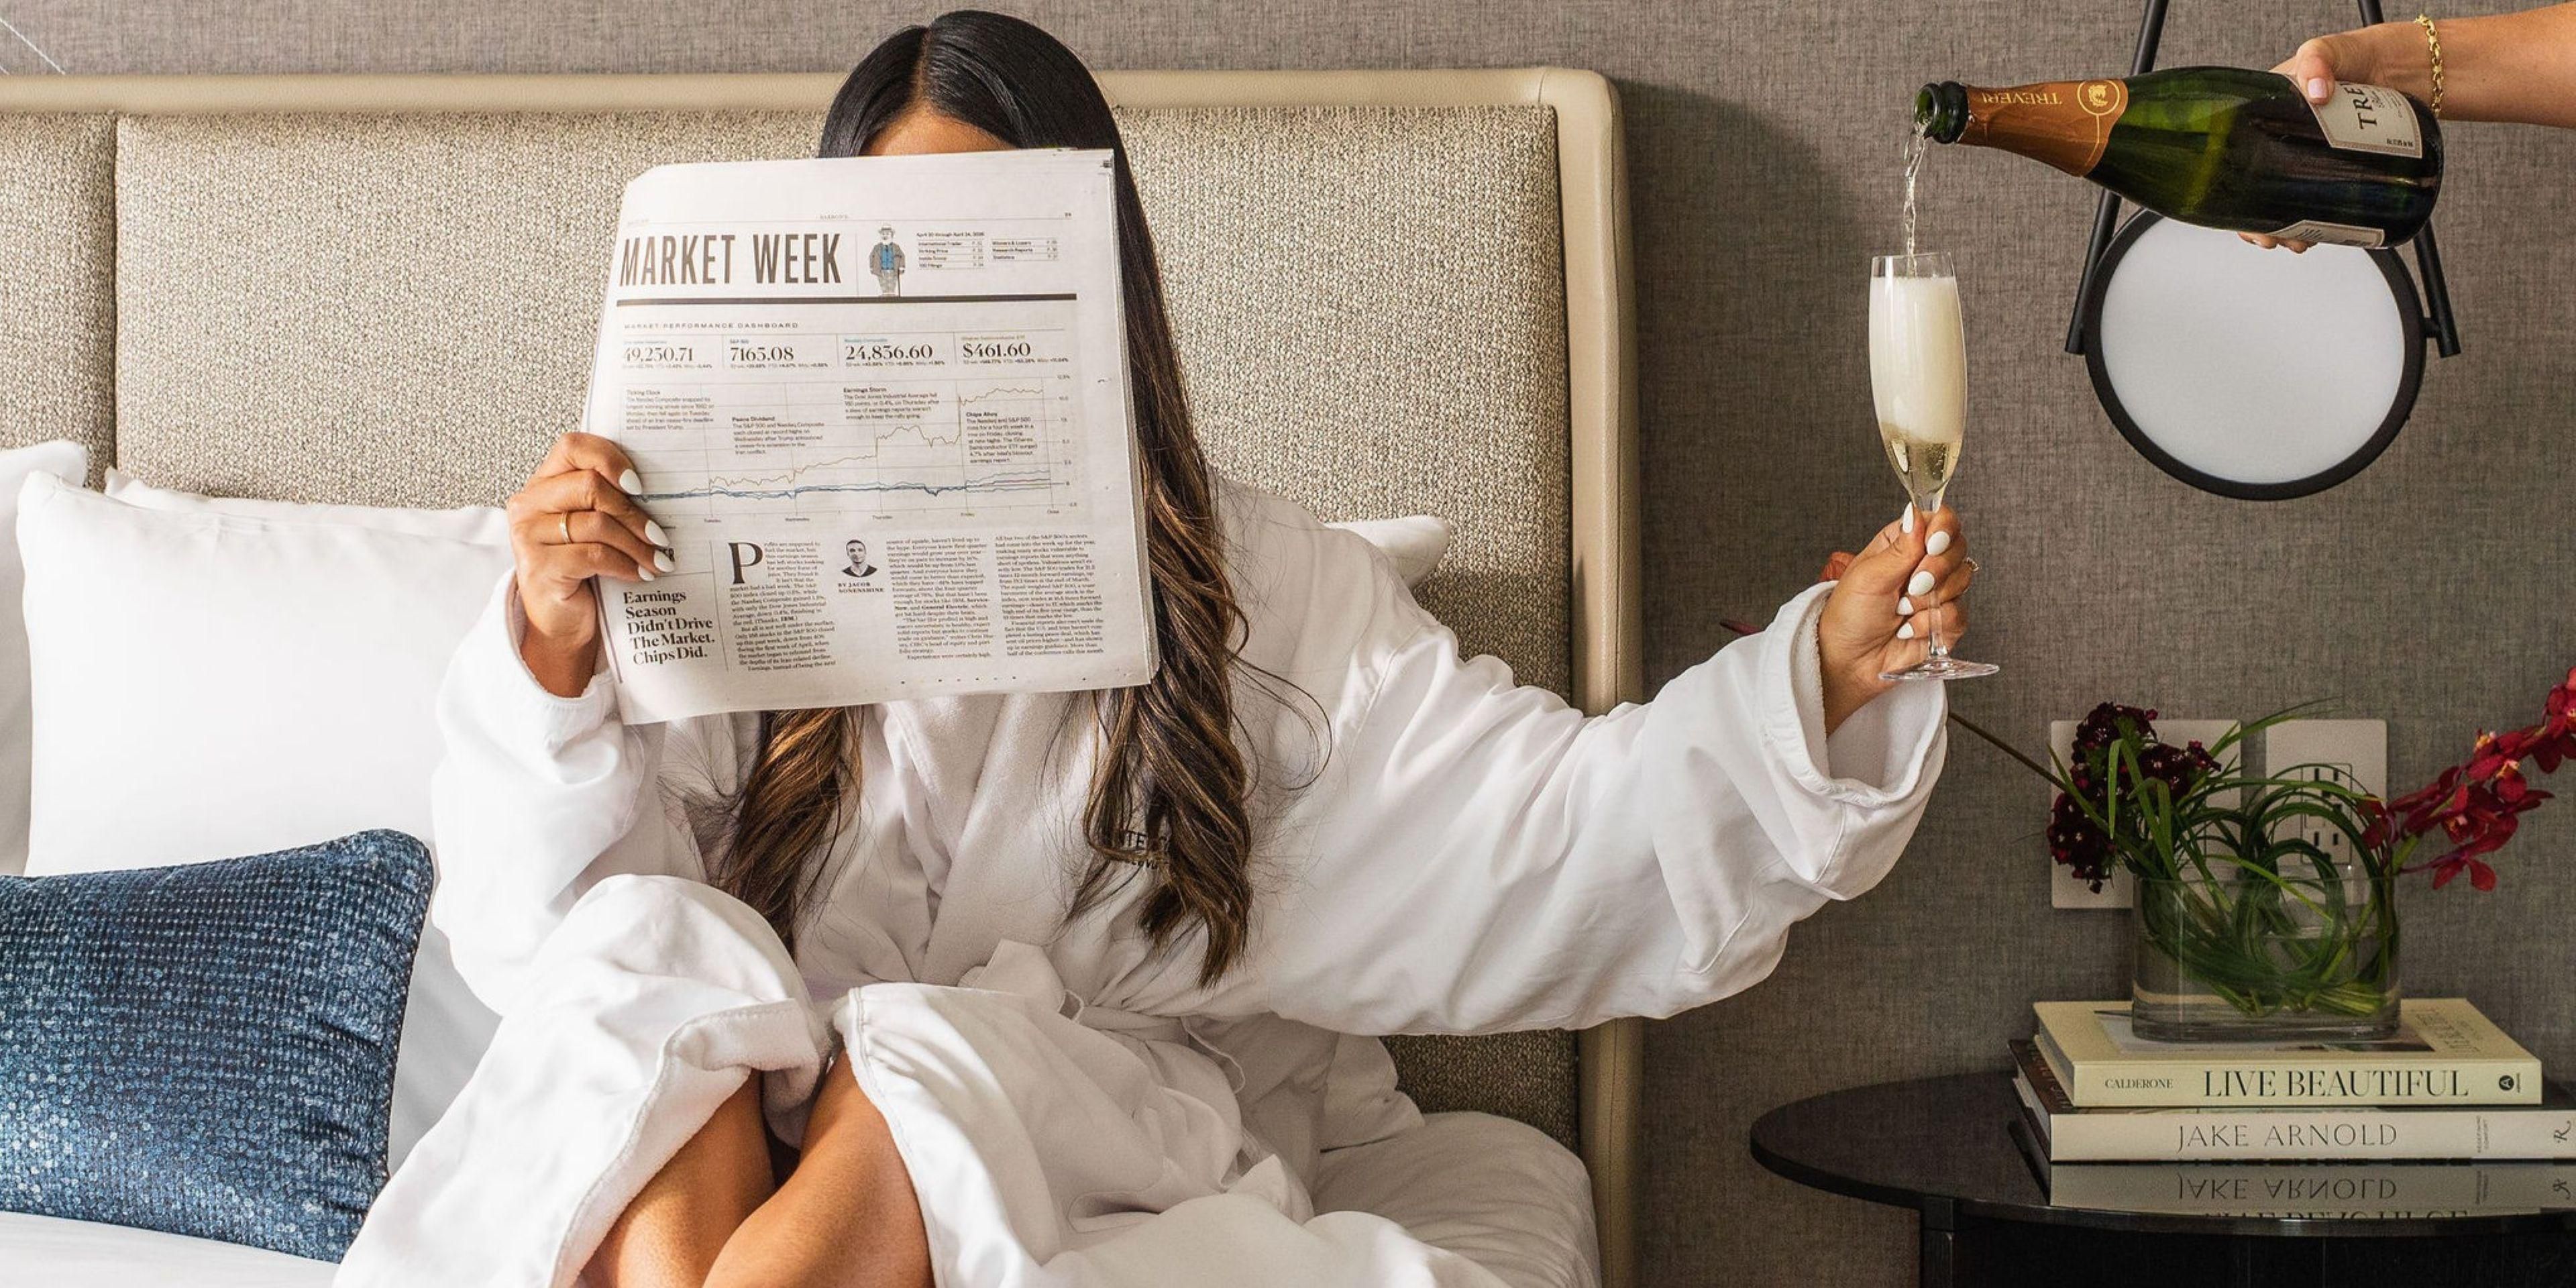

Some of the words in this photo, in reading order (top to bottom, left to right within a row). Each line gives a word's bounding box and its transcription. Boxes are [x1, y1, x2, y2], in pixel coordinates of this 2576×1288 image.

[1982, 92, 2063, 105] TREVERI
[2341, 83, 2378, 129] TRE
[619, 235, 736, 286] MARKET
[753, 233, 841, 284] WEEK
[730, 346, 794, 362] 7165.08
[963, 341, 1031, 358] $461.60
[623, 590, 687, 604] Earnings
[625, 606, 676, 619] Season
[628, 619, 674, 635] Didn't
[675, 617, 713, 630] Drive
[630, 636, 659, 649] The
[661, 632, 715, 645] Market.
[633, 650, 676, 665] Chips
[676, 646, 708, 659] Did.
[2104, 1079, 2174, 1089] CALDERONE
[2203, 1071, 2277, 1098] LIVE
[2286, 1070, 2469, 1097] BEAUTIFUL
[2177, 1125, 2249, 1152] JAKE
[2265, 1124, 2398, 1147] ARNOLD
